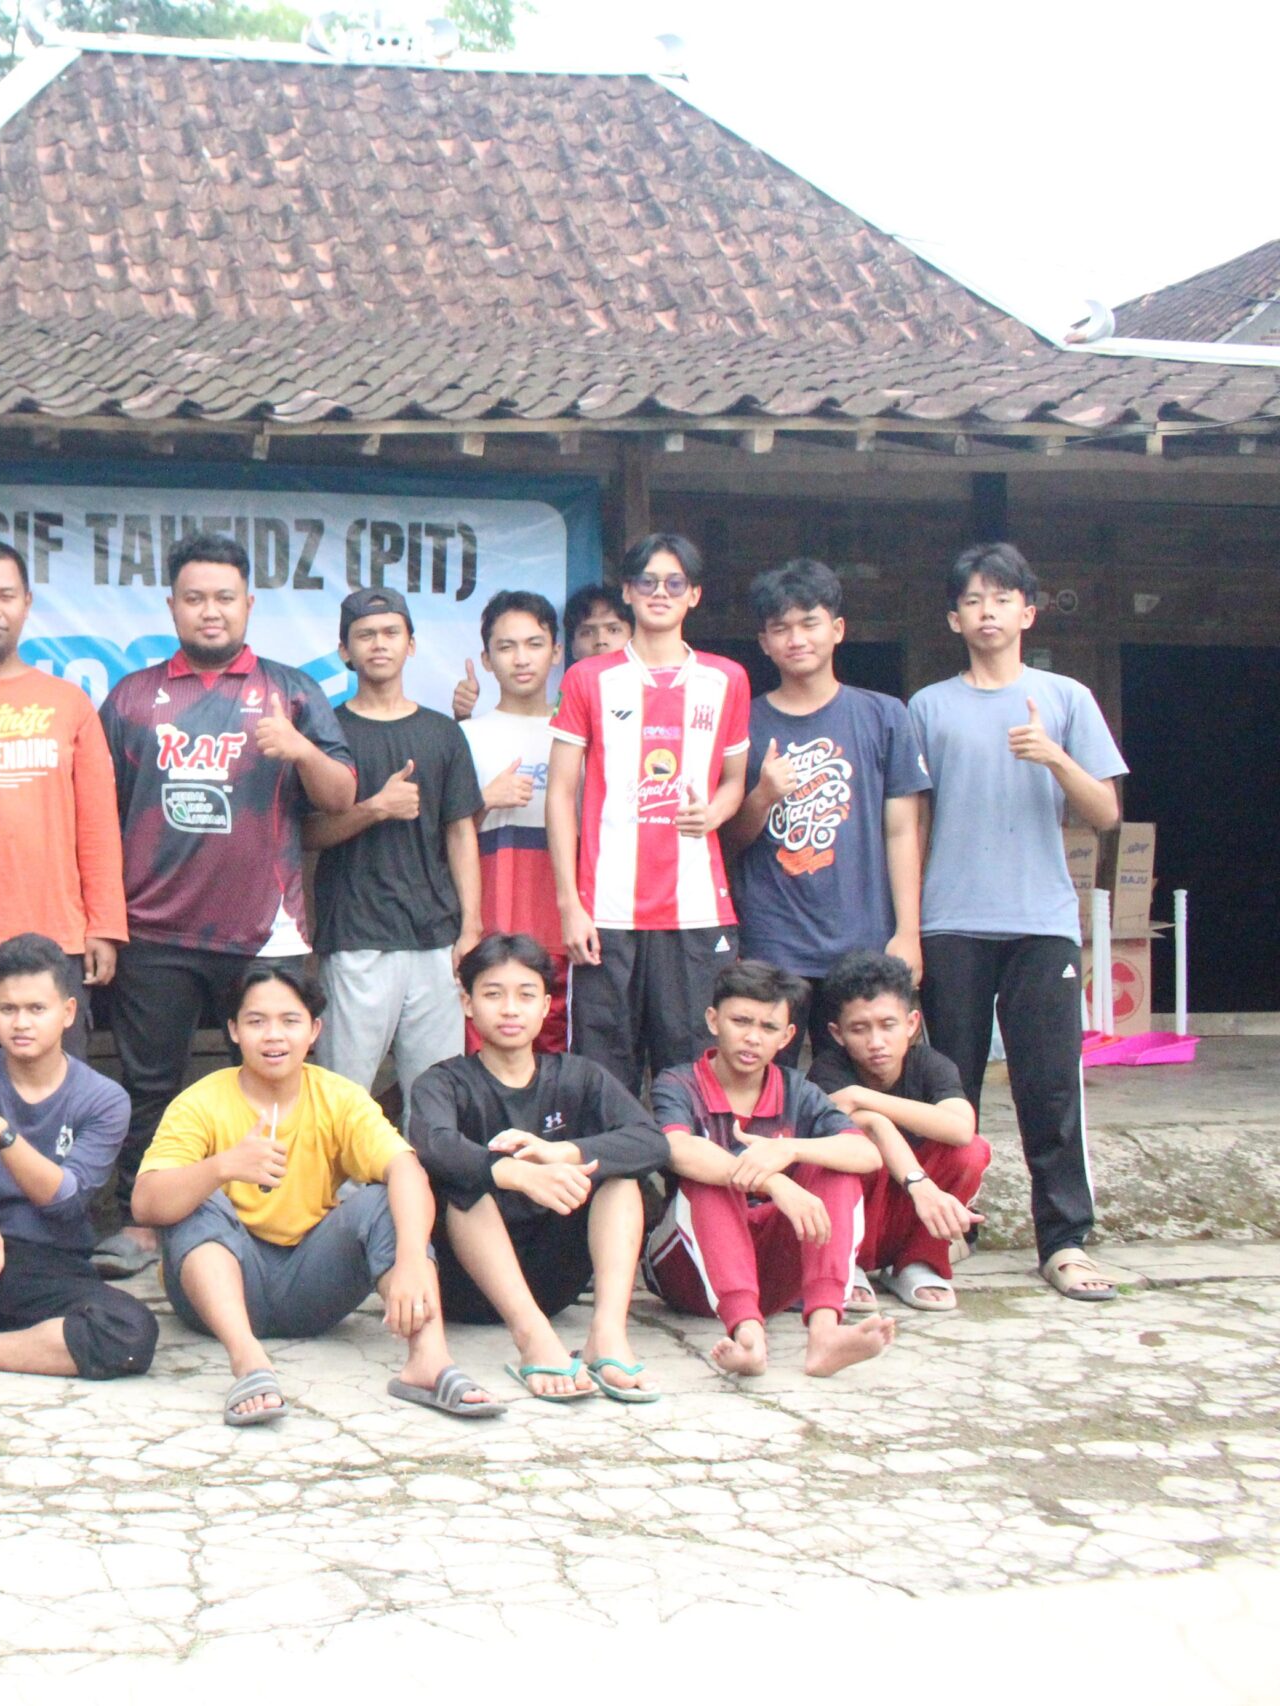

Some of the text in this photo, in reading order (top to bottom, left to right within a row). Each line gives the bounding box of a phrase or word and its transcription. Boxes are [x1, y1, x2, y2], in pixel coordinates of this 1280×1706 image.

[85, 513, 325, 590] TAIDZ
[345, 517, 477, 602] (PIT)
[158, 731, 247, 770] KAF
[1120, 875, 1148, 885] BAJU
